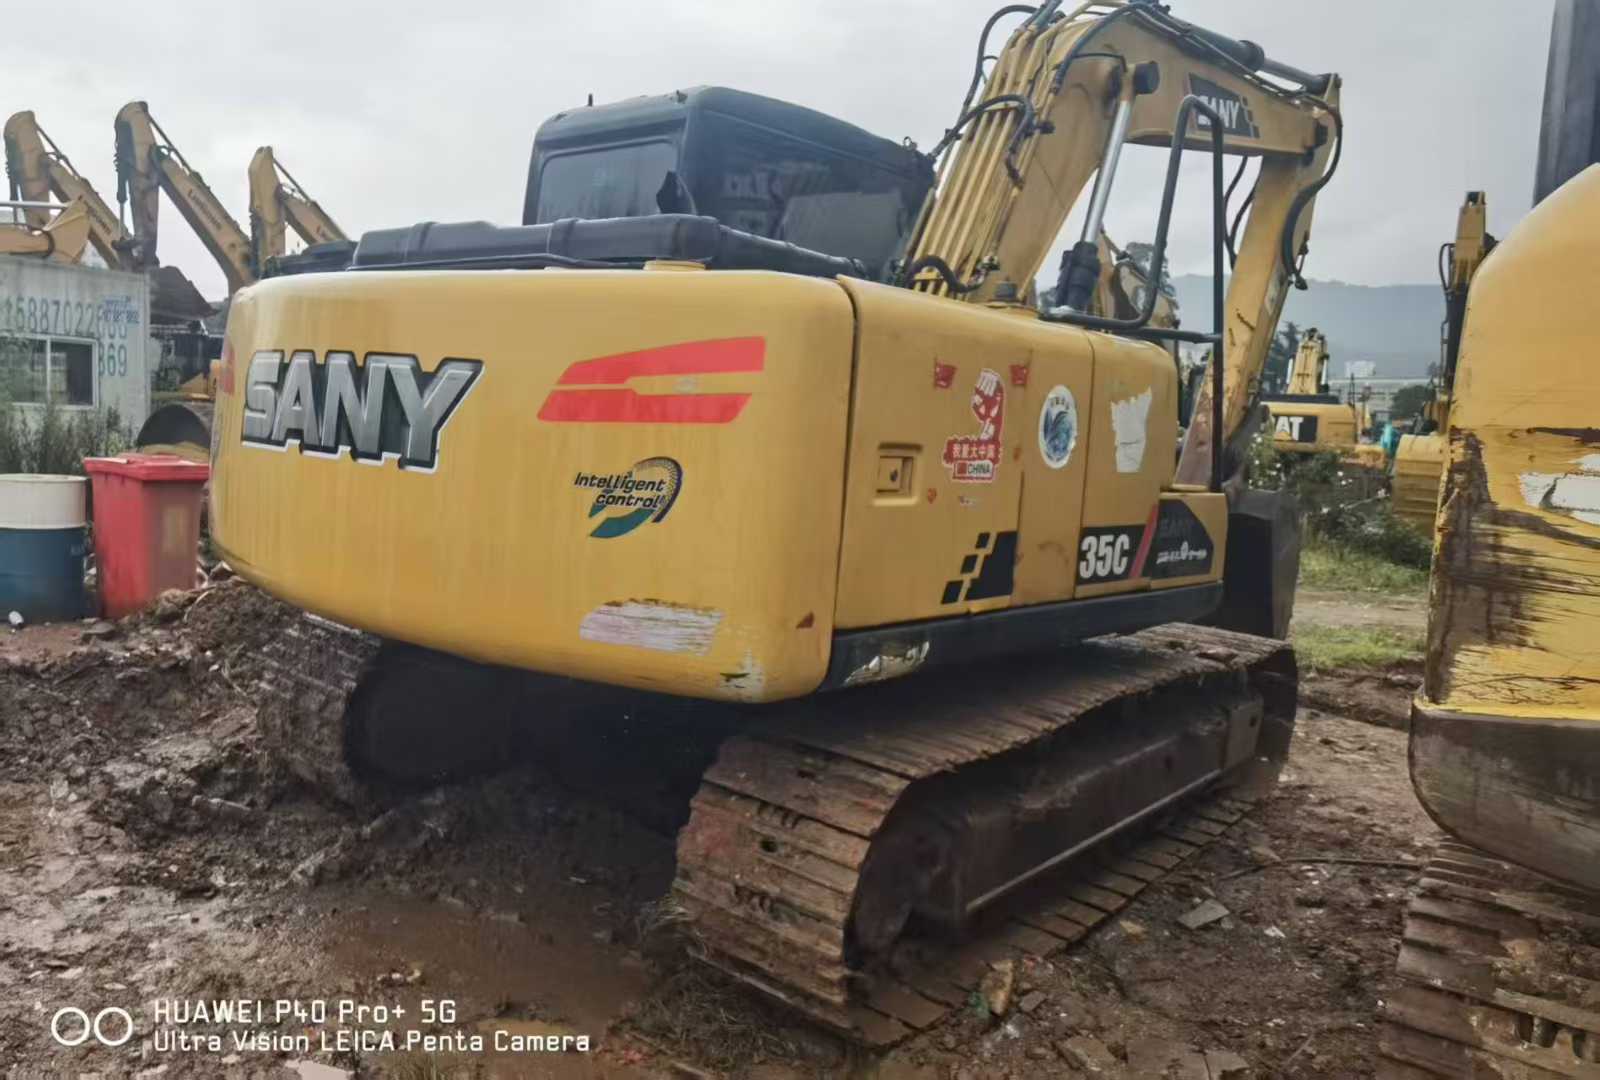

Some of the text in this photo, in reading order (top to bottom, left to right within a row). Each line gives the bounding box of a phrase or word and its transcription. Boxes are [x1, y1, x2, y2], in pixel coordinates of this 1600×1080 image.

[242, 350, 484, 474] SANY
[1275, 415, 1304, 441] AT
[968, 463, 991, 474] CHINA
[574, 472, 667, 493] Intelligent
[595, 494, 660, 508] control
[1079, 534, 1130, 579] 35C
